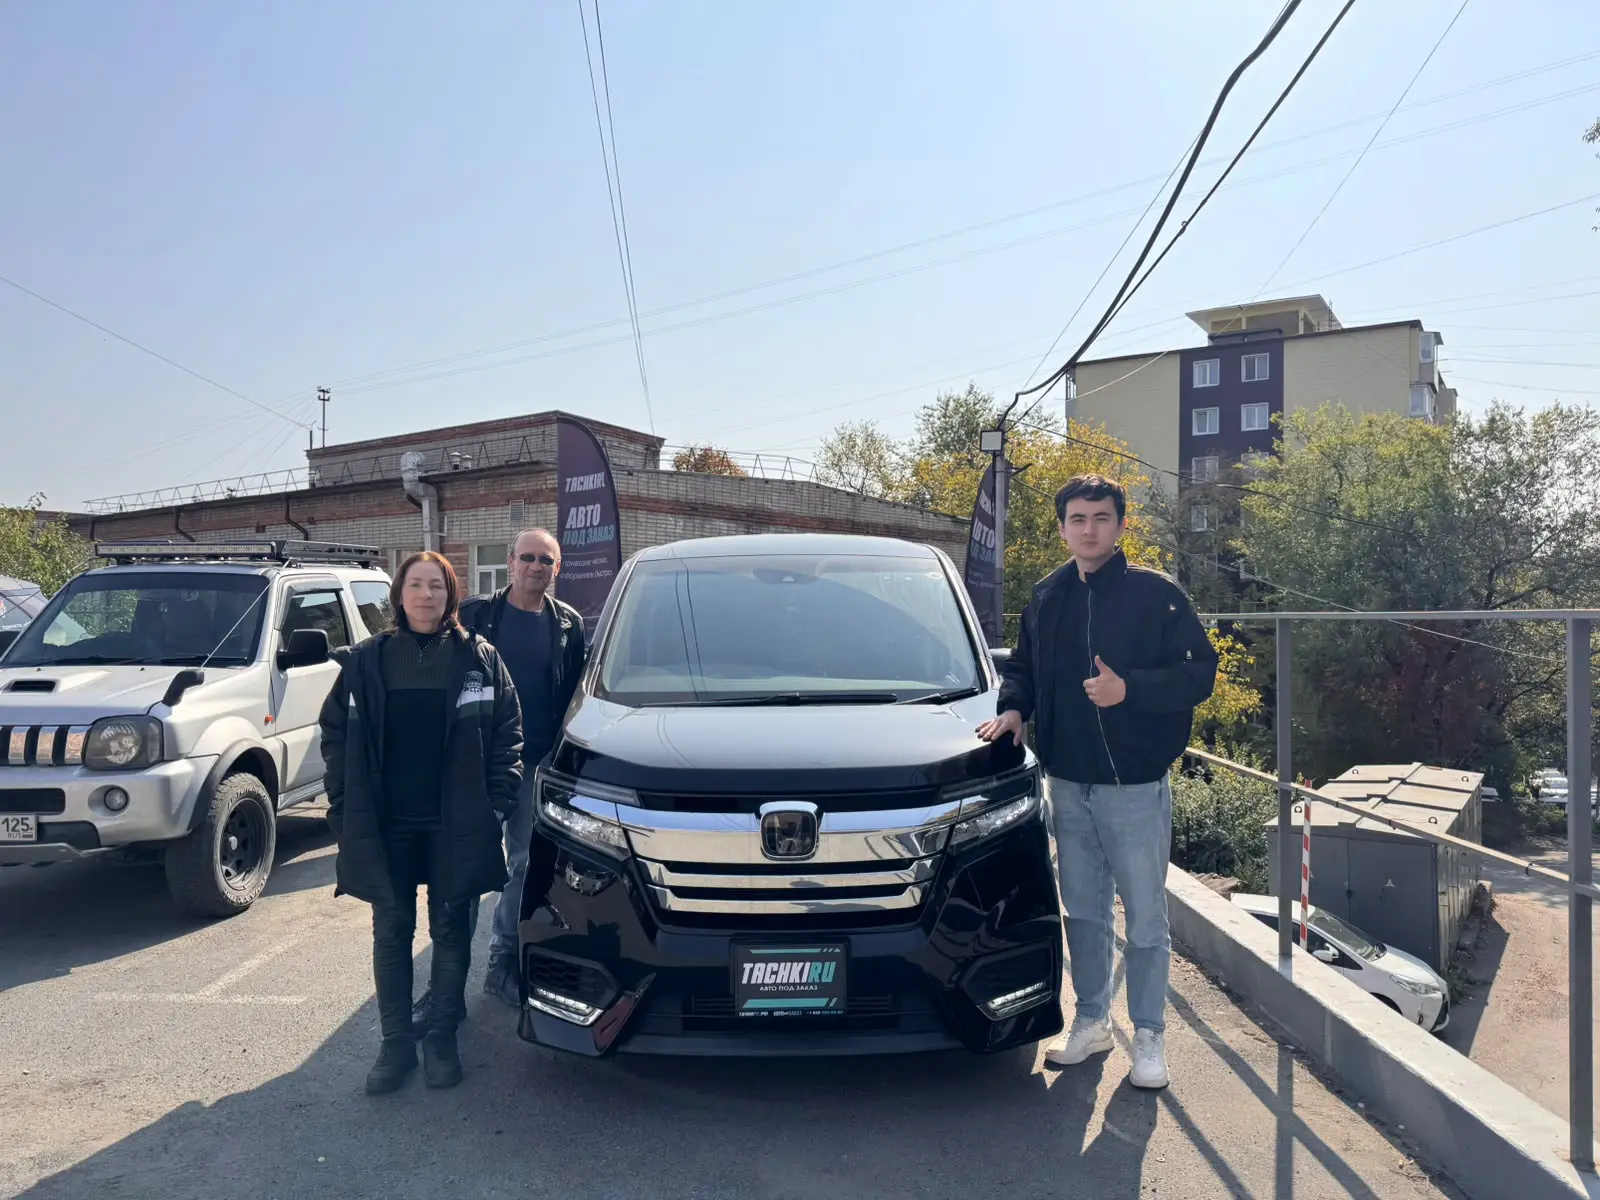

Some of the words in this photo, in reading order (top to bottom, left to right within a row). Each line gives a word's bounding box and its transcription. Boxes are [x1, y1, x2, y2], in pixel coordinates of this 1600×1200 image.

[565, 503, 601, 529] АВТО
[562, 529, 586, 548] ПОД
[586, 524, 615, 545] ЗАКАЗ
[1, 817, 30, 833] 125
[741, 961, 837, 985] TACHKIRU
